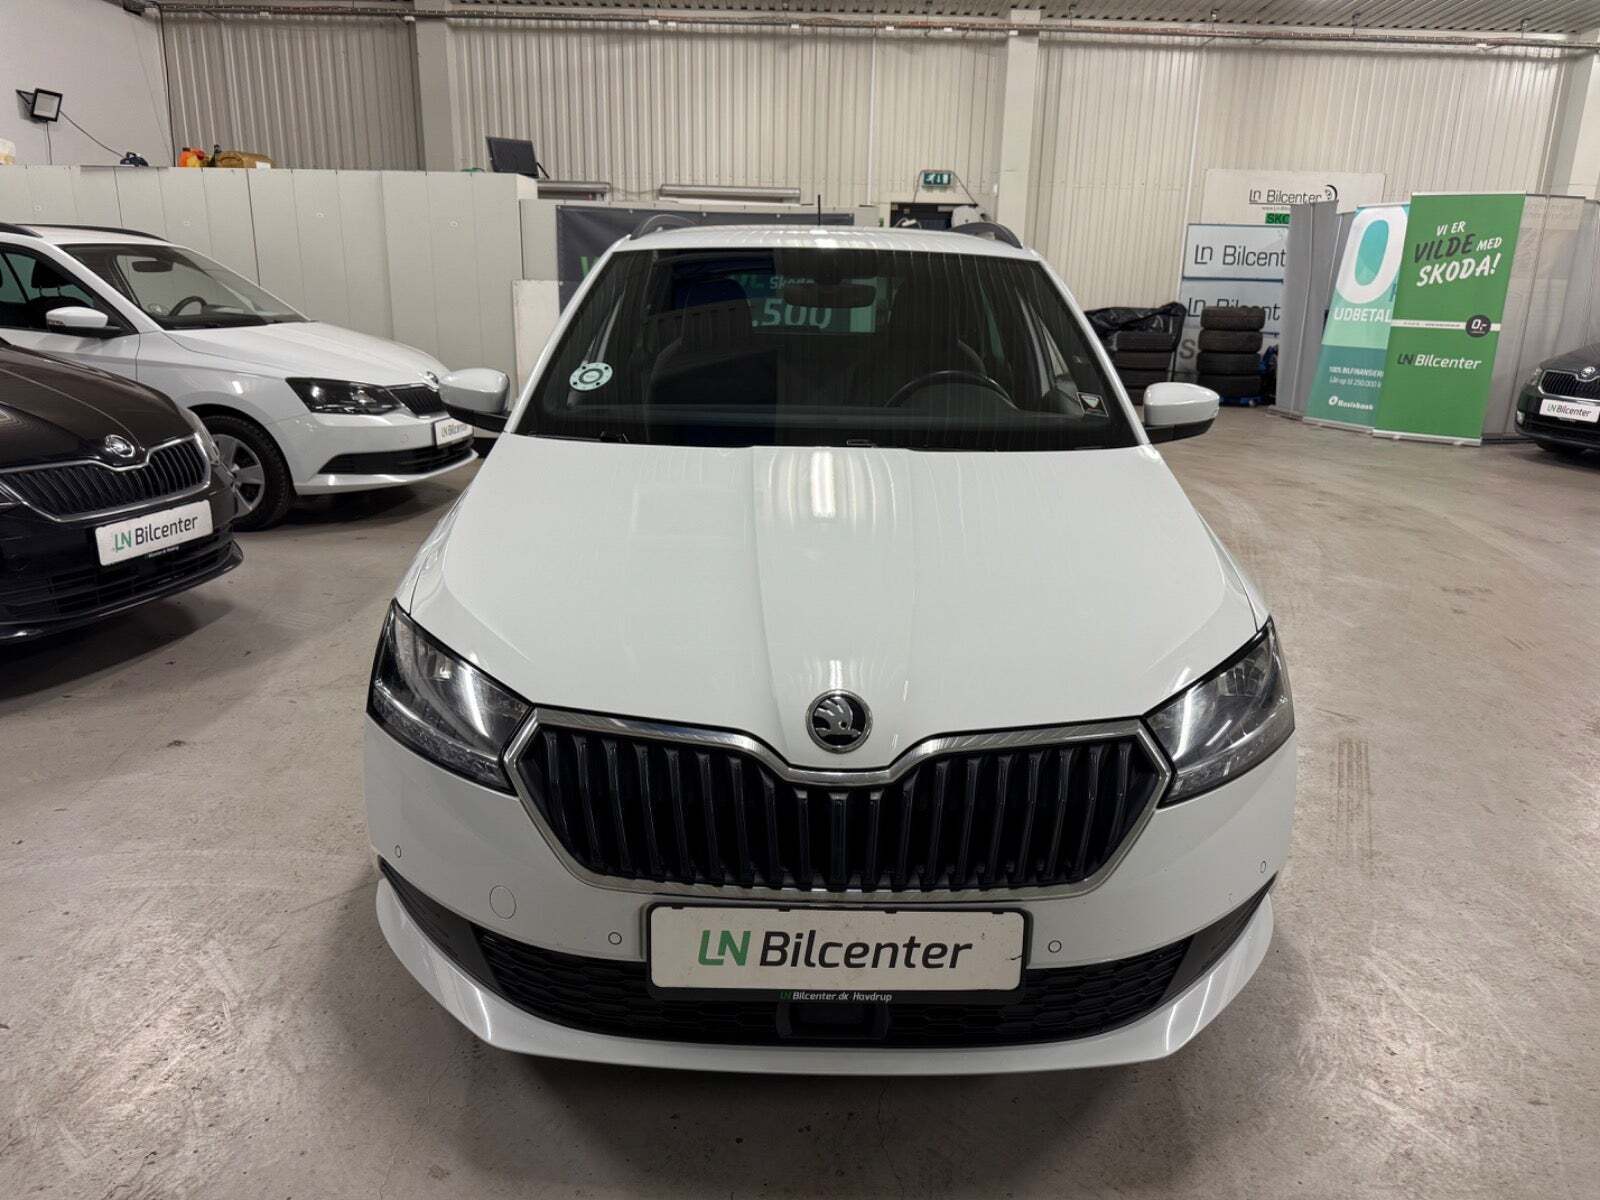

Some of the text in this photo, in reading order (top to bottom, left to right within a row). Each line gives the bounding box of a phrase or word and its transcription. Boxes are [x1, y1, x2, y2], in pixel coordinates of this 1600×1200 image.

[1266, 189, 1322, 204] Bilcenter
[1266, 214, 1290, 223] SKO
[1436, 220, 1466, 236] VI ER
[1222, 245, 1286, 267] Bilcent
[1414, 233, 1502, 263] VILDE MED
[1416, 253, 1502, 287] SKODA!
[1333, 307, 1392, 323] UDBETAL
[1415, 354, 1482, 369] Bilcenter
[1557, 405, 1592, 416] Bilcenter
[115, 516, 198, 552] LN Bilcenter
[697, 929, 972, 969] LN Bilcenter
